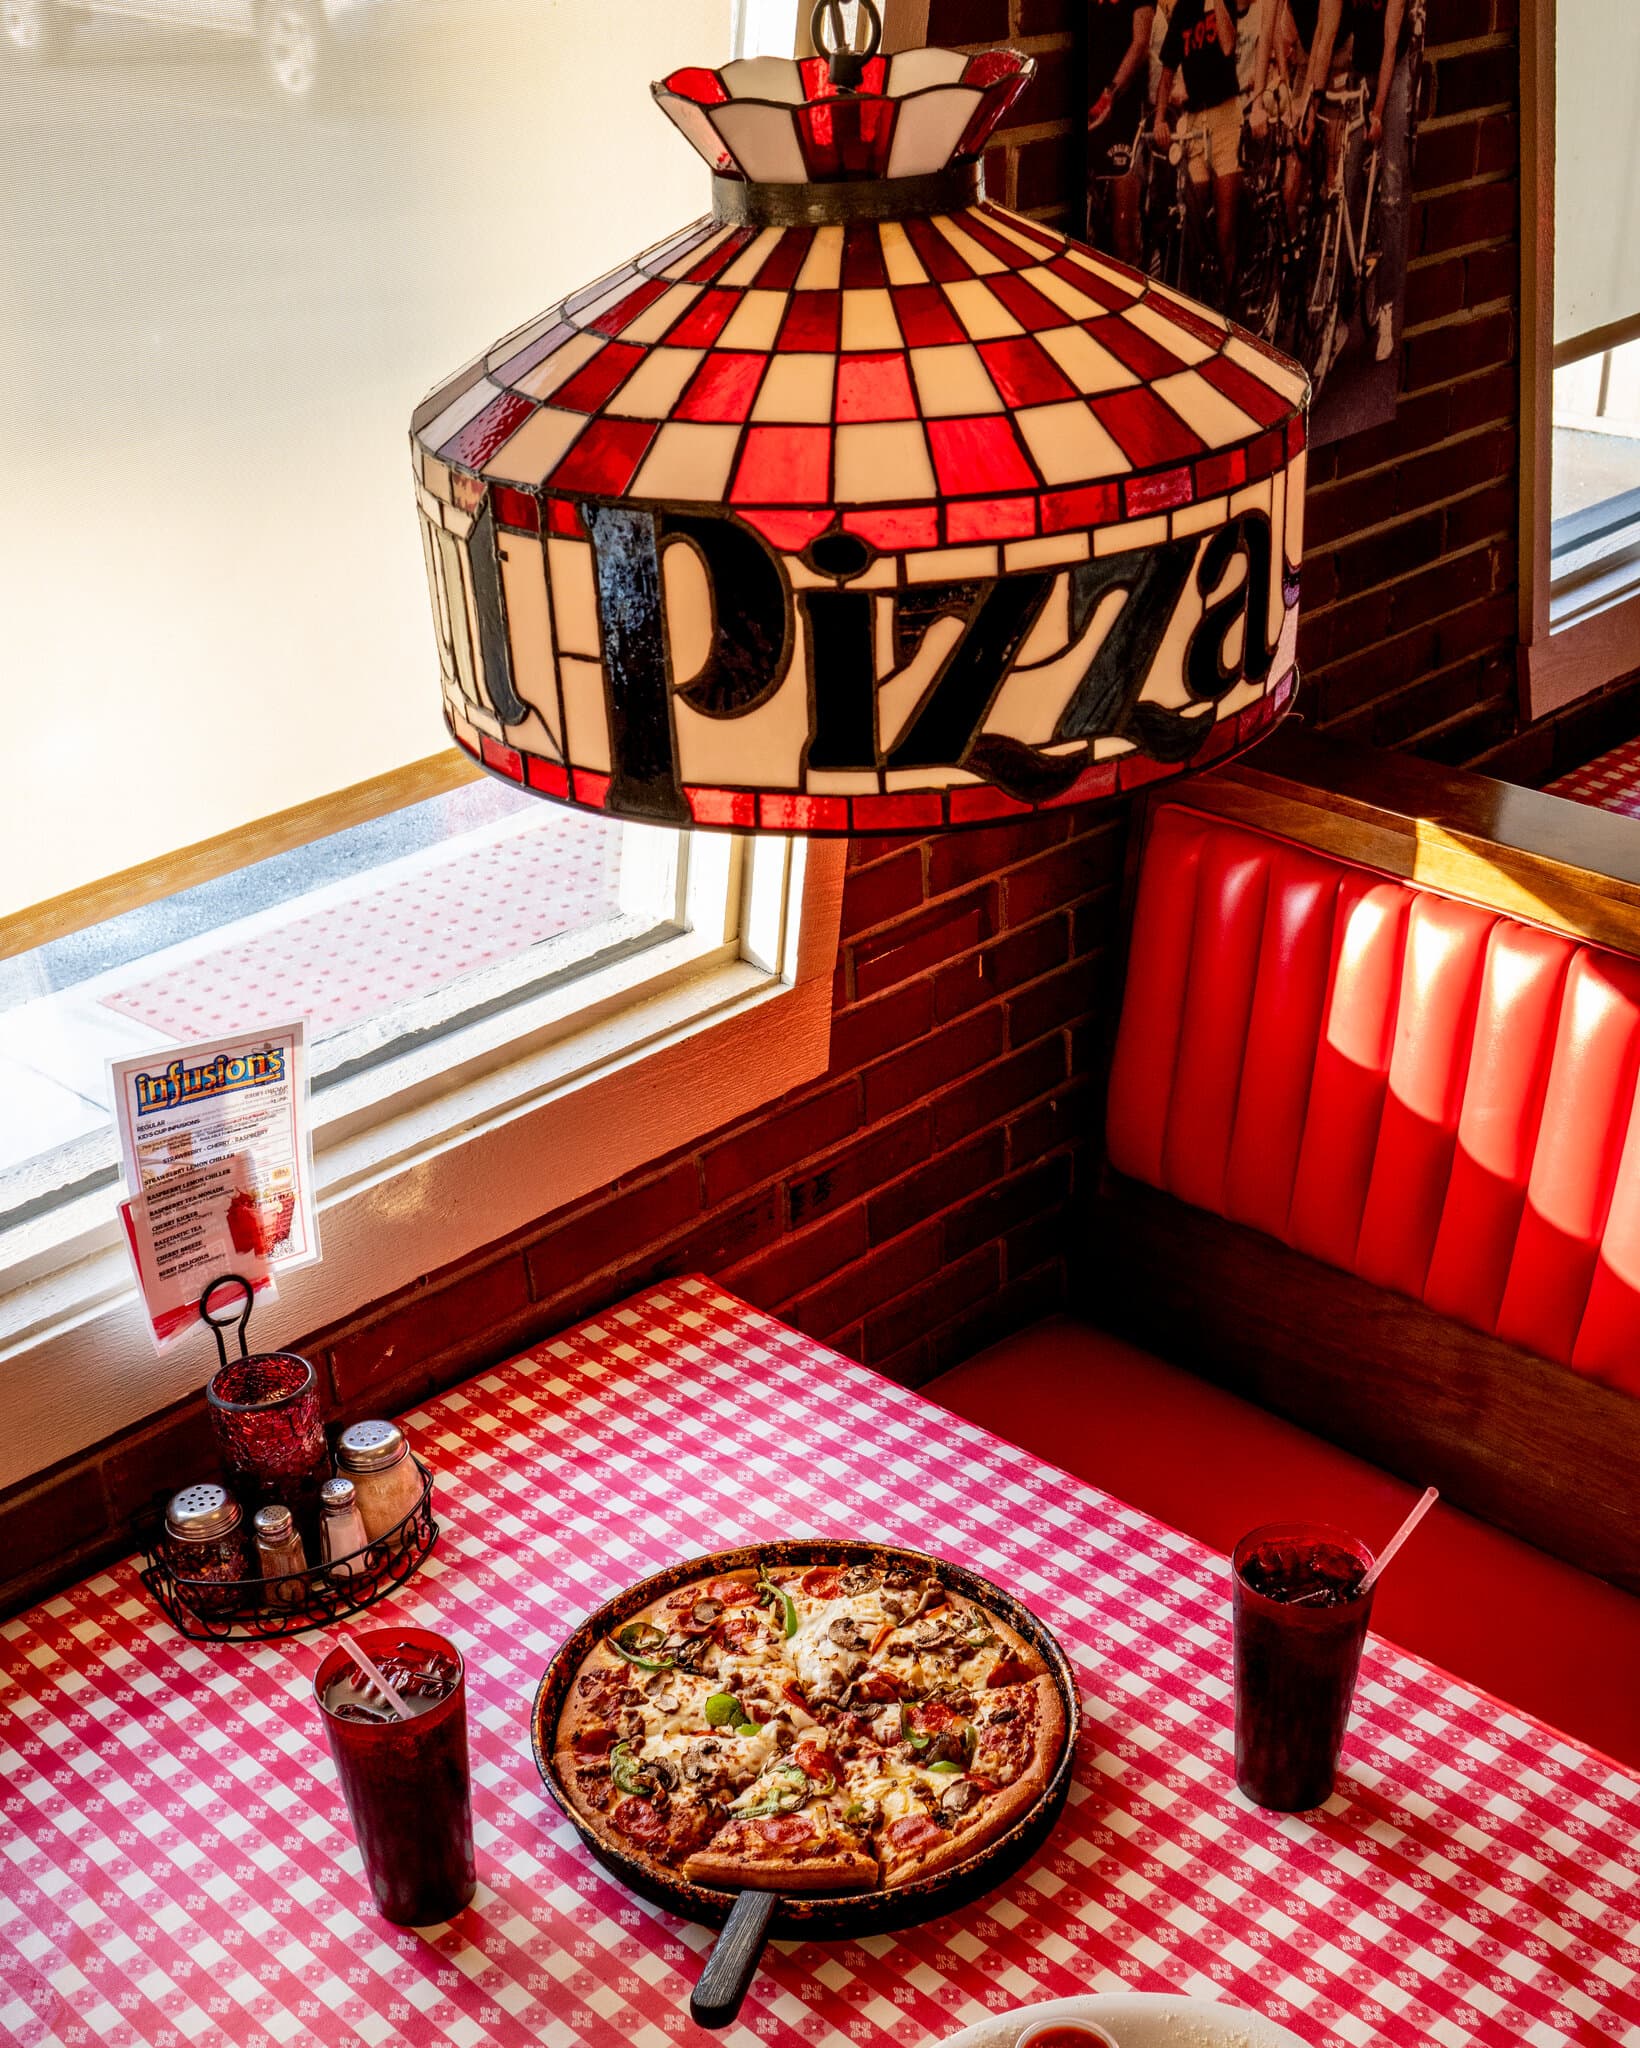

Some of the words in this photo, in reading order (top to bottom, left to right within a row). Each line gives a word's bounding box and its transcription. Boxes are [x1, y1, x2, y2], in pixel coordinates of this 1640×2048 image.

[582, 501, 1281, 820] Pizza
[137, 1050, 283, 1106] infusions
[137, 1120, 165, 1132] REGULAR
[163, 1147, 201, 1164] STRAWBERRY
[207, 1139, 231, 1150] CHERRY
[145, 1168, 184, 1185] STRAWBERRY
[187, 1161, 207, 1171] LEMON
[209, 1153, 235, 1164] CHILLER
[147, 1185, 181, 1200] RASPBERRY
[183, 1178, 204, 1188] LEMON
[205, 1169, 231, 1180] CHILLER
[150, 1200, 183, 1216] RASPBERRY
[152, 1220, 174, 1231] CHERRY
[176, 1211, 198, 1222] KICKER
[157, 1249, 179, 1261] CHERRY
[180, 1240, 202, 1252] BREEZE
[159, 1266, 177, 1276] BERRY
[178, 1253, 209, 1269] DELICIOUS
